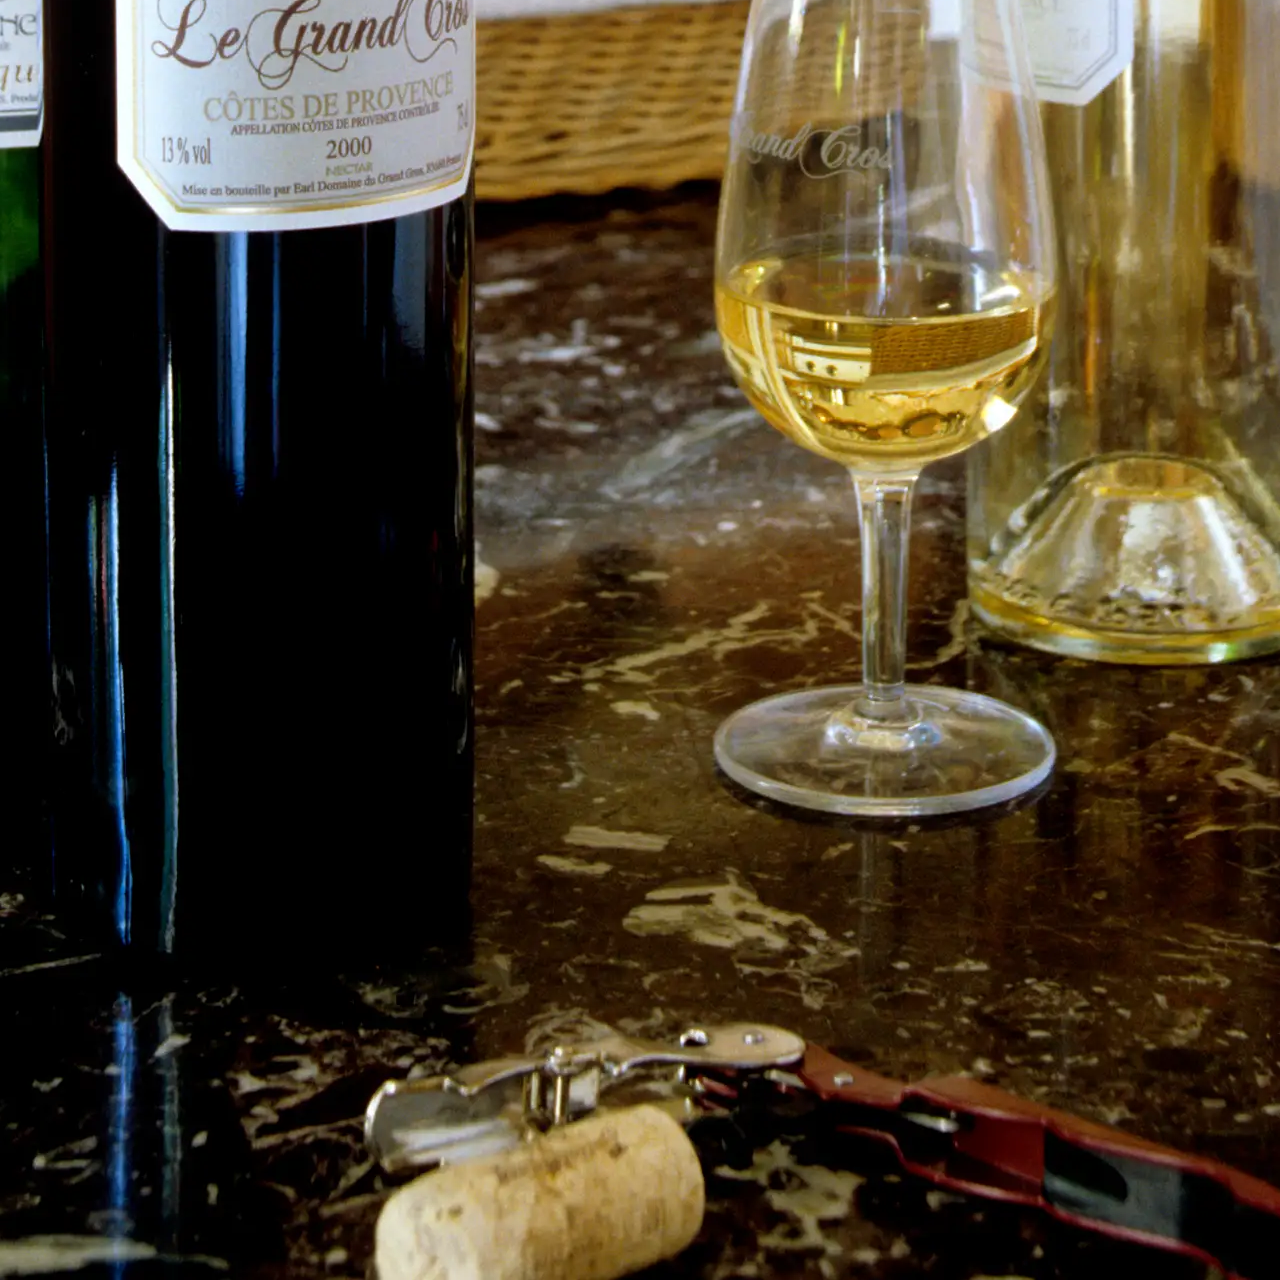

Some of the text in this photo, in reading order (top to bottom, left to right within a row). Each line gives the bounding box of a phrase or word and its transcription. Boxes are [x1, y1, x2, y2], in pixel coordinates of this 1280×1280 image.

[203, 90, 295, 123] CÔTES
[302, 92, 339, 120] DE
[346, 69, 454, 116] PROVENCE
[231, 122, 300, 136] APPELLATION
[336, 118, 349, 130] DE
[350, 110, 397, 129] PROVENCE
[162, 136, 211, 165] 13 % vol
[326, 135, 373, 160] 2000
[799, 125, 893, 179] Cros
[325, 161, 374, 177] NECTAR
[182, 184, 207, 196] Mise
[225, 183, 272, 197] bouteille
[273, 186, 290, 199] par
[317, 177, 363, 193] Domaine
